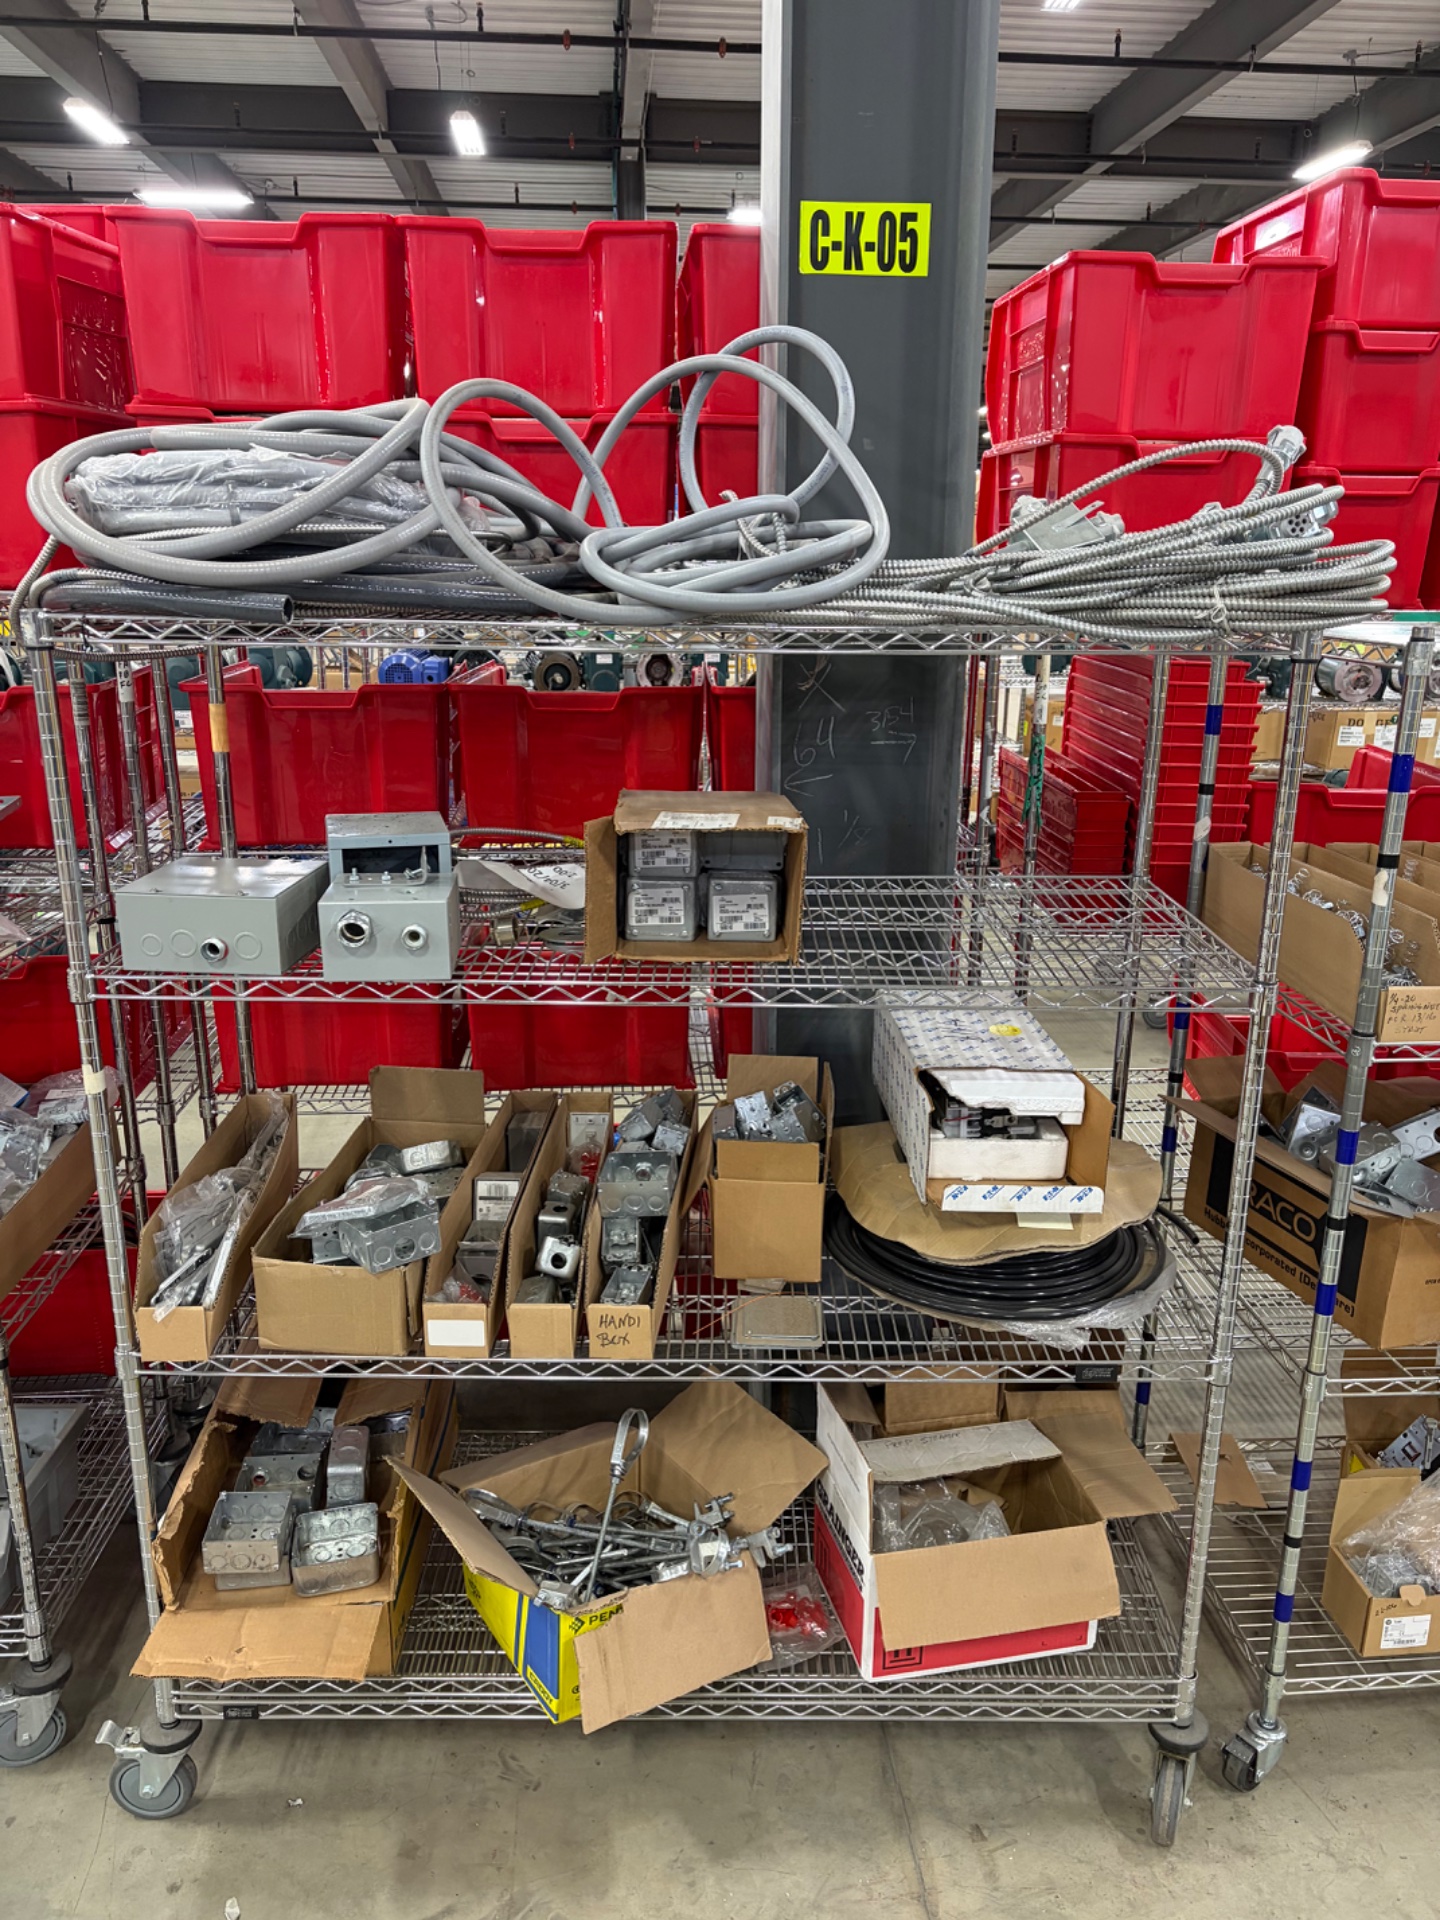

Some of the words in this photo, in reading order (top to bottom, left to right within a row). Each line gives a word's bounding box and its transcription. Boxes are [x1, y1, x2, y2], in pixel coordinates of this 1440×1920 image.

[809, 209, 918, 273] C-K-05
[1347, 718, 1392, 727] DOGE
[1249, 1180, 1316, 1244] RACO
[1244, 1238, 1297, 1277] corporated
[599, 1313, 641, 1330] HANDI
